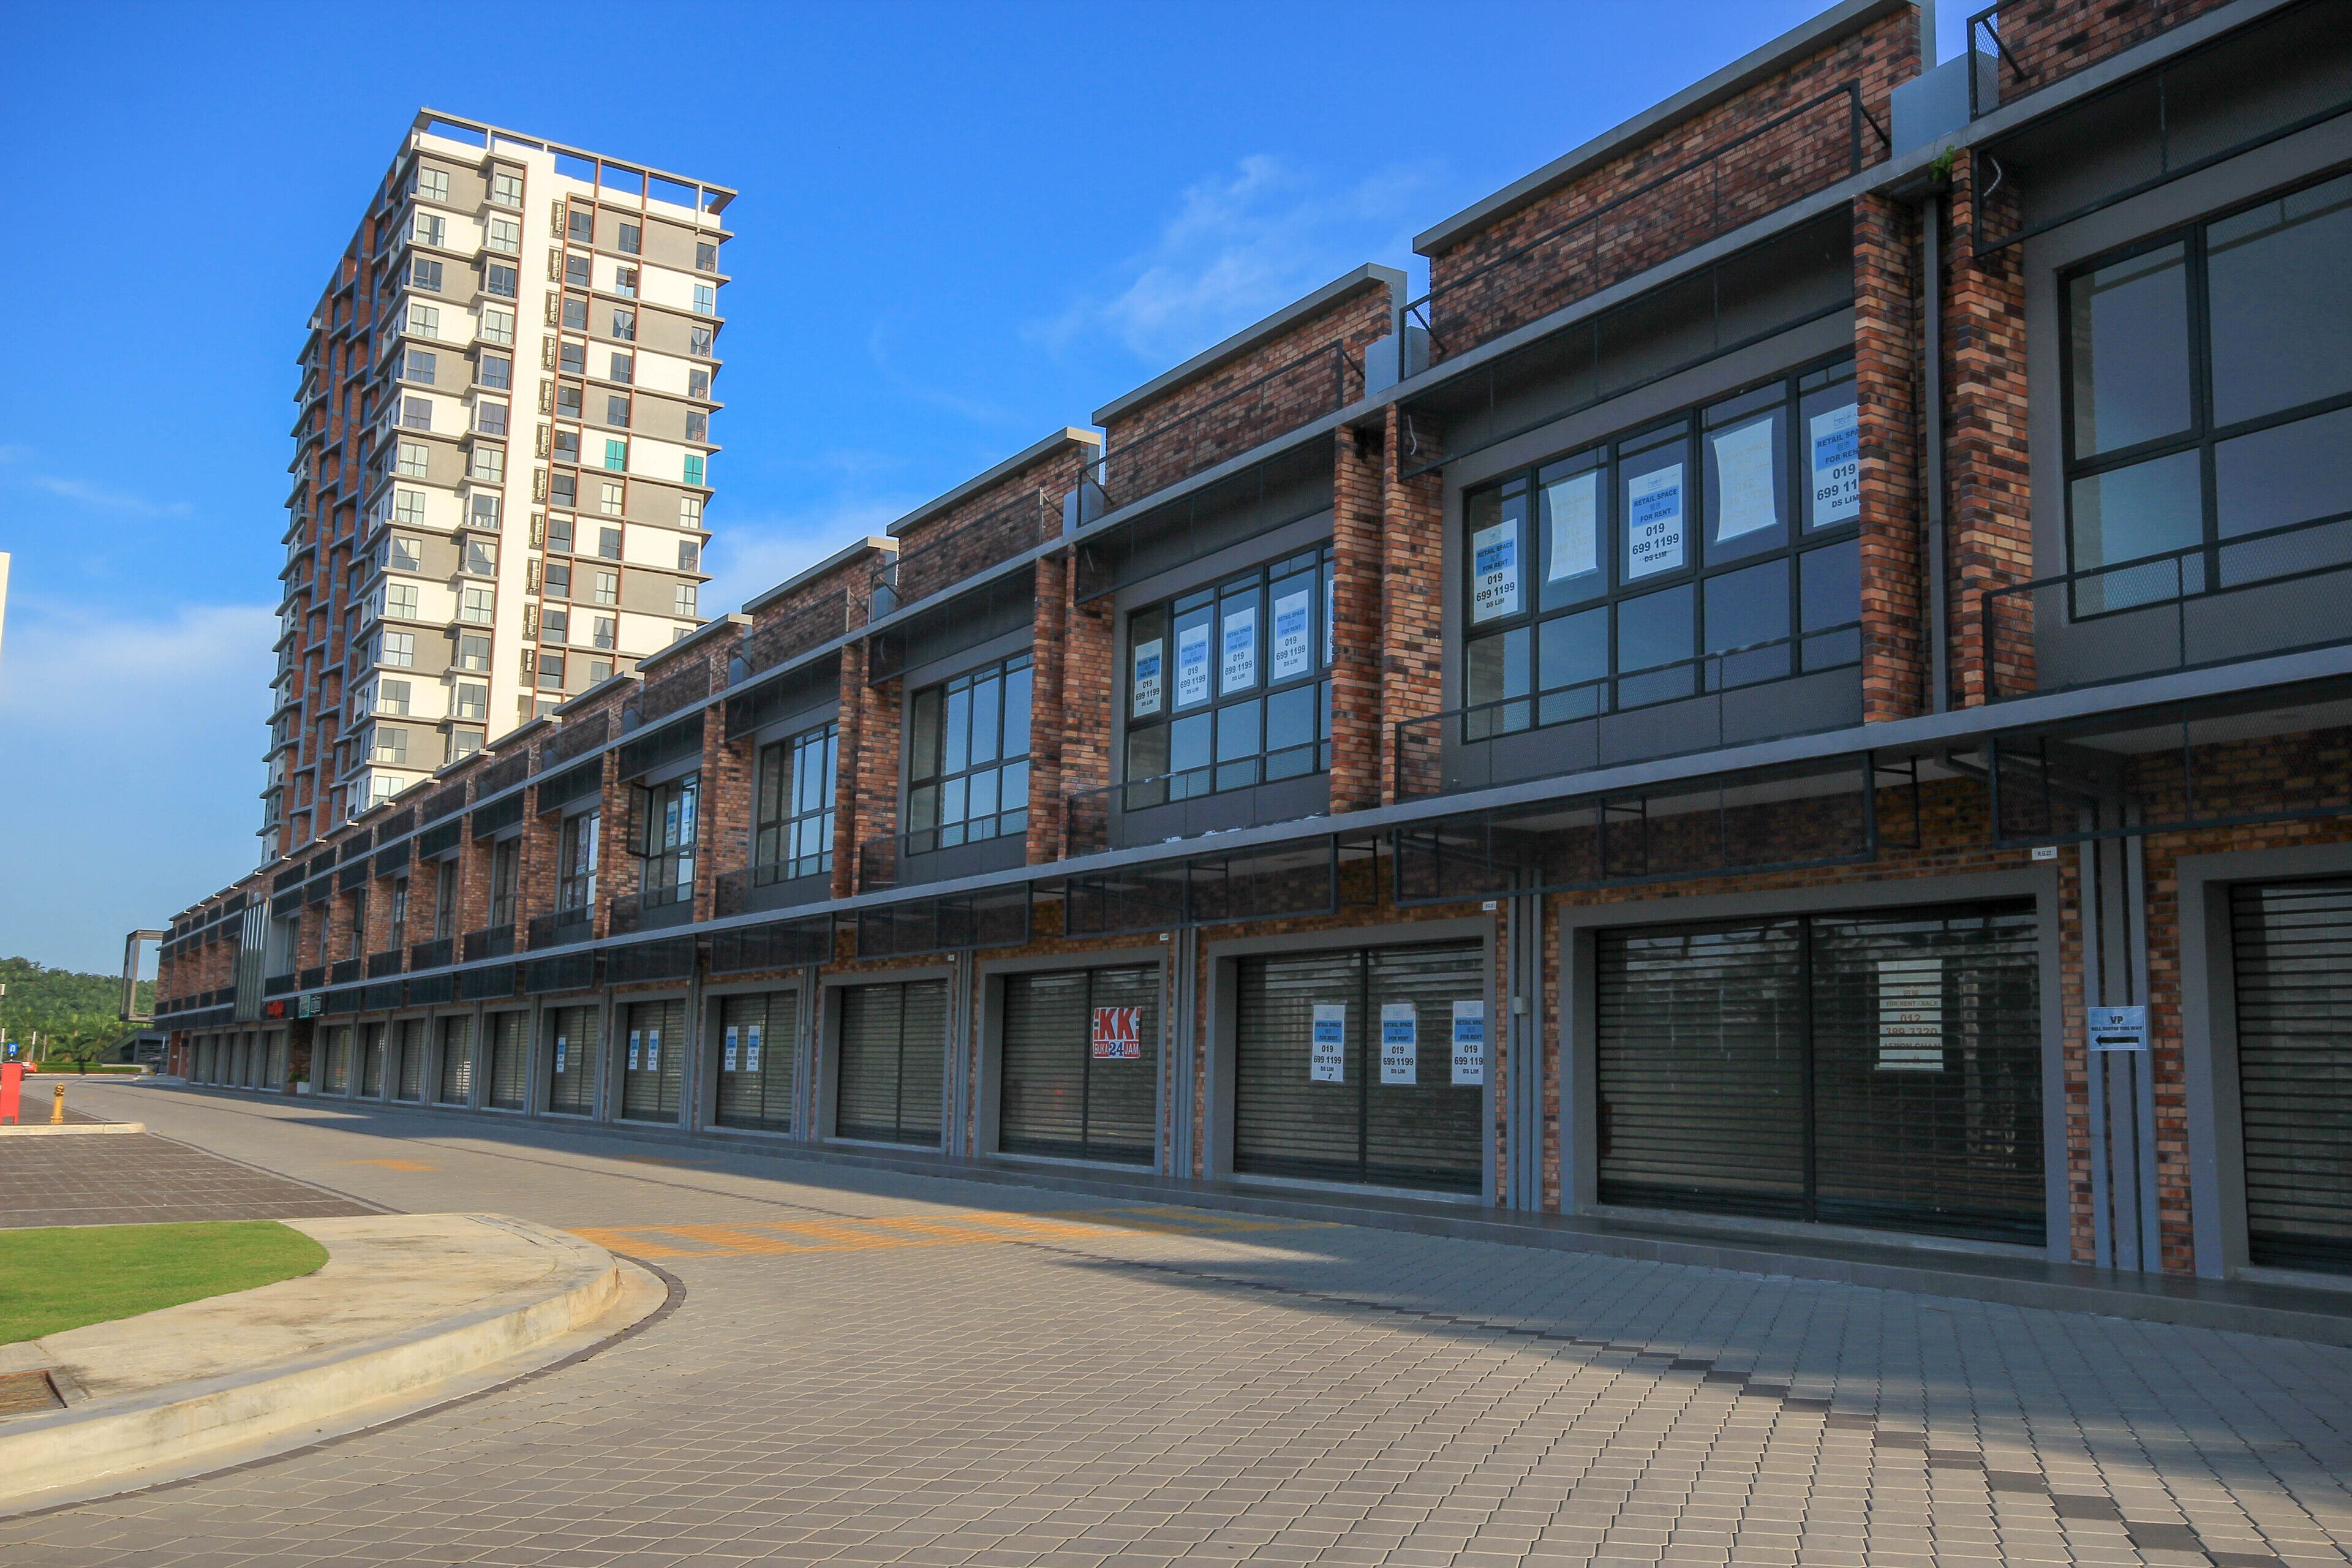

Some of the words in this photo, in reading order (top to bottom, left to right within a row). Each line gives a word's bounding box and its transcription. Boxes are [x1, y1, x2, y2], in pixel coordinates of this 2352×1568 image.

[1818, 434, 1843, 448] RETAIL
[1845, 429, 1858, 439] SPA
[1825, 454, 1841, 464] FOR
[1842, 449, 1858, 459] REN
[1833, 464, 1855, 479] 019
[1817, 485, 1839, 500] 699
[1844, 478, 1856, 492] 11
[1634, 497, 1655, 507] RETAIL
[1657, 488, 1677, 500] SPACE
[1832, 499, 1842, 508] DS
[1640, 513, 1653, 522] FOR
[1654, 508, 1671, 519] RENT
[1646, 523, 1665, 537] 019
[1477, 548, 1494, 558] RETAIL
[1496, 541, 1513, 551] SPACE
[1632, 541, 1651, 554] 699
[1654, 533, 1679, 548] 1199
[1654, 550, 1667, 559] LIM
[1494, 559, 1508, 568] RENT
[1488, 573, 1502, 584] 019
[1477, 589, 1491, 601] 699
[1494, 582, 1514, 595] 1199
[1495, 598, 1504, 606] LIM
[1285, 636, 1297, 646] 019
[1233, 652, 1244, 662] 019
[1276, 650, 1287, 660] 699
[1290, 645, 1305, 655] 1199
[1188, 666, 1198, 675] 019
[1225, 665, 1236, 675] 699
[1238, 661, 1252, 671] 1199
[1143, 679, 1152, 688] 019
[1180, 679, 1190, 688] 699
[1193, 674, 1205, 685] 1199
[1147, 688, 1159, 697] 1199
[1101, 1008, 1135, 1039] KK
[1095, 1044, 1107, 1054] BUKA
[1109, 1042, 1124, 1056] 24
[1125, 1044, 1139, 1054] JAM
[1455, 1057, 1467, 1065] 699
